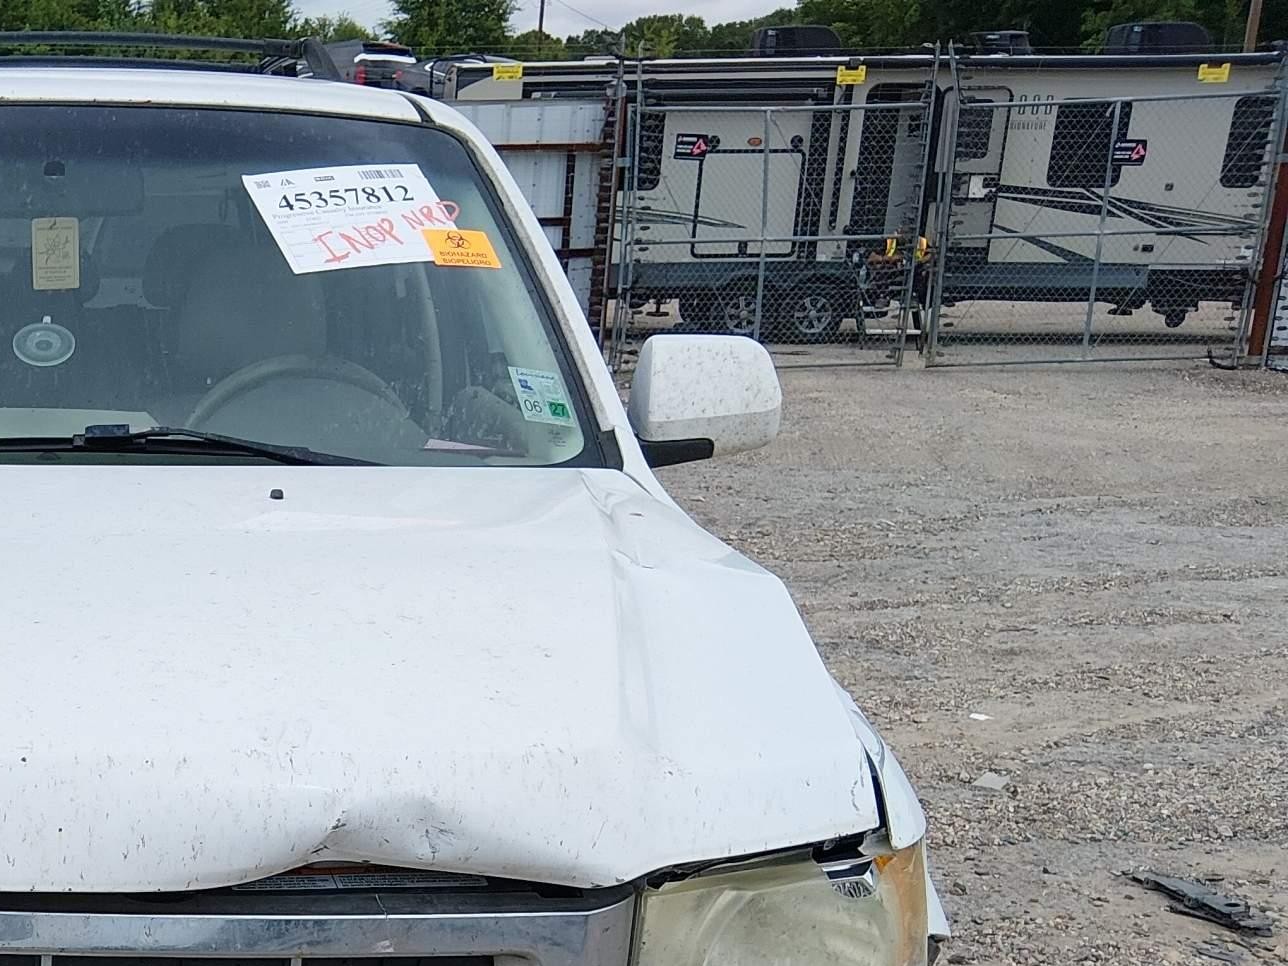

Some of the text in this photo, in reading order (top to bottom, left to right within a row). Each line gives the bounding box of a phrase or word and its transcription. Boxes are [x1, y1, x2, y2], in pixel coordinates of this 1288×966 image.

[278, 184, 415, 211] 45357812
[313, 217, 405, 264] INOP
[439, 250, 488, 259] BIOHAZARD
[442, 257, 492, 266] BIOPELIGRO
[523, 399, 567, 418] 06 27
